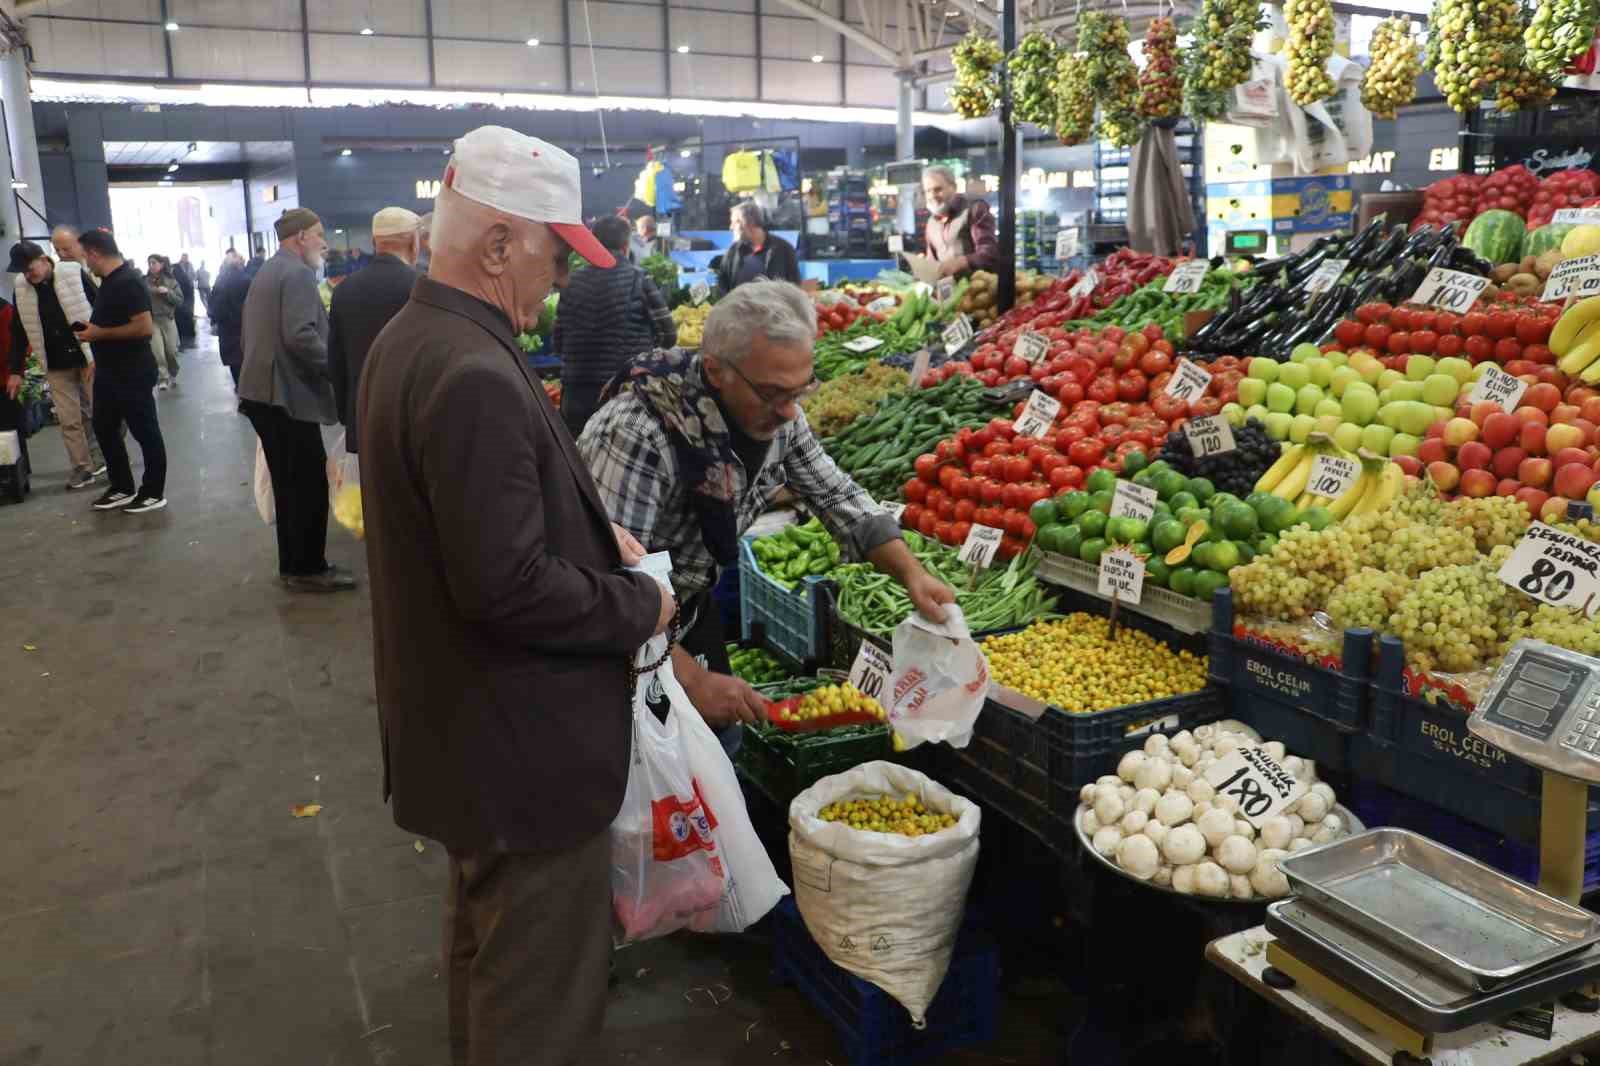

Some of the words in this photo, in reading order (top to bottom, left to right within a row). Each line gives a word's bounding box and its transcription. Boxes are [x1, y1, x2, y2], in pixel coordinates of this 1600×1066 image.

[1426, 285, 1469, 308] 100
[1201, 435, 1221, 455] 120
[1313, 474, 1341, 494] 100
[1519, 558, 1574, 601] 80
[1247, 659, 1274, 679] EROL
[858, 667, 884, 698] 100
[1421, 721, 1457, 746] EROL
[1214, 766, 1273, 817] 180
